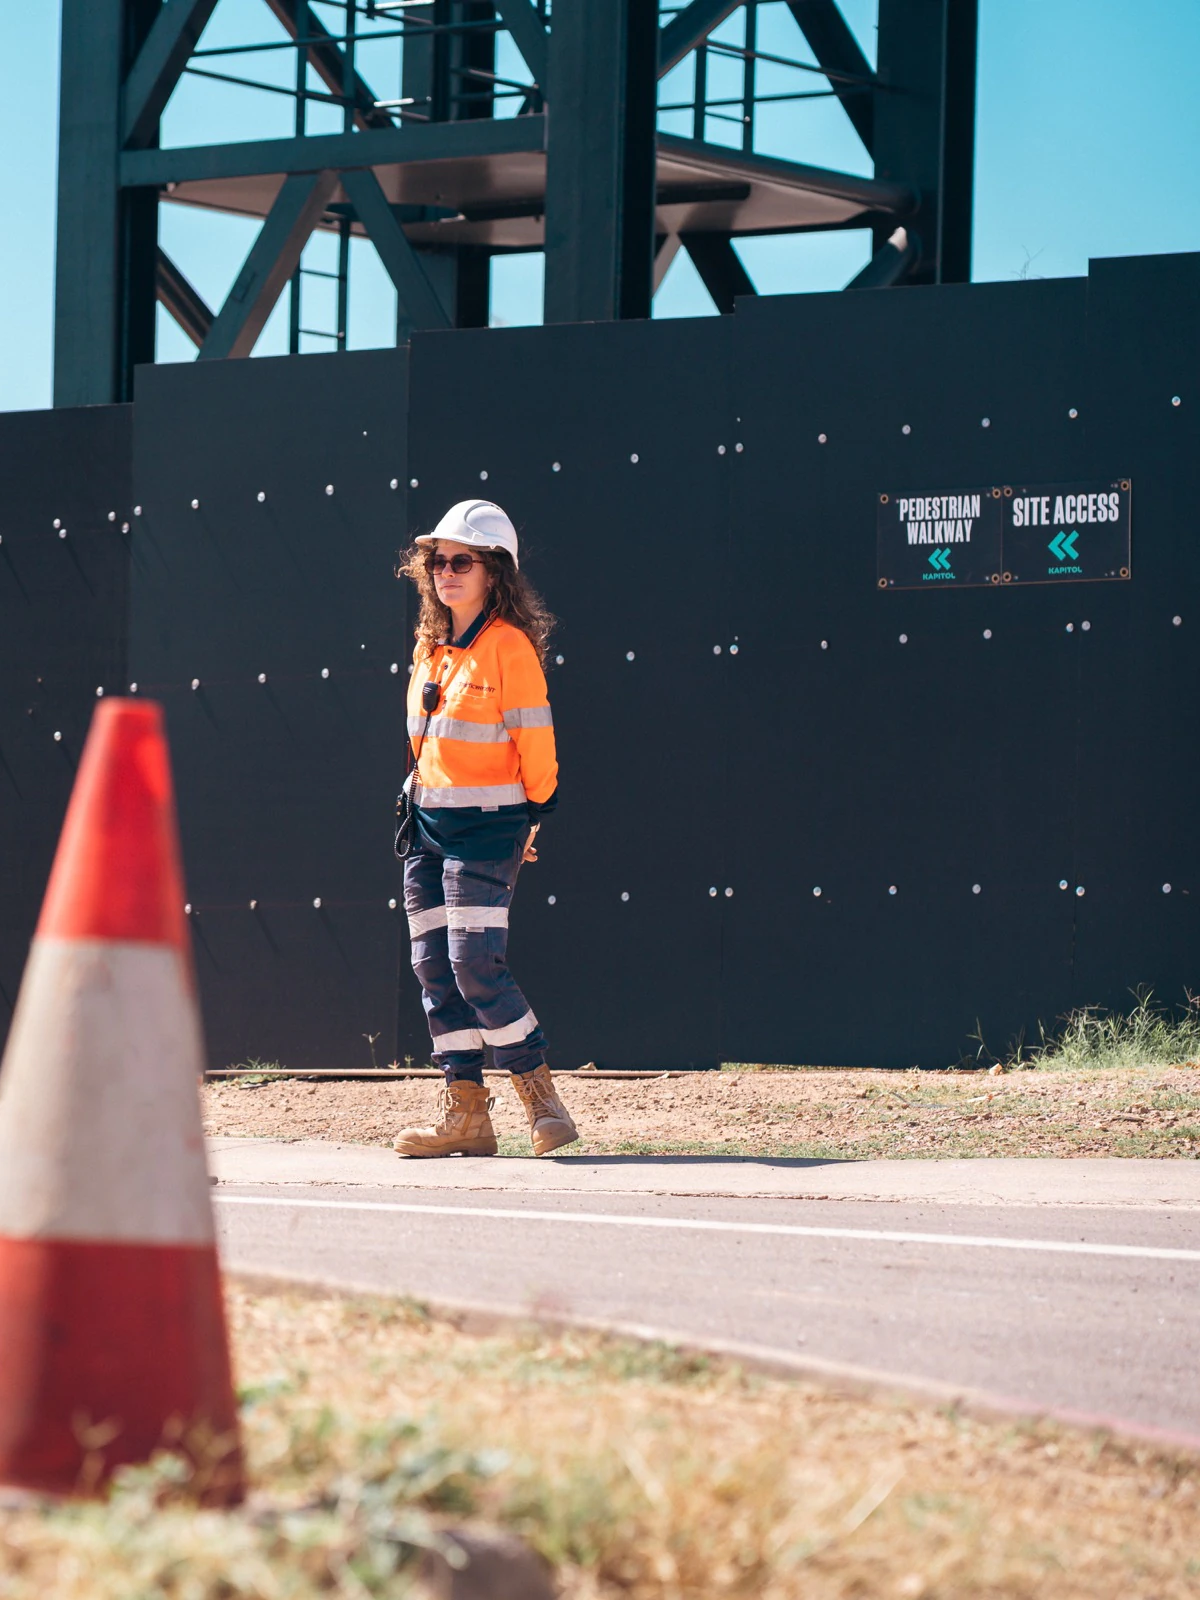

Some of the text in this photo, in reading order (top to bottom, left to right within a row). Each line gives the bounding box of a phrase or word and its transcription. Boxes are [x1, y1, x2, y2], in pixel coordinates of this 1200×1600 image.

[899, 494, 981, 521] PEDESTRIAN
[1012, 492, 1120, 527] SITE ACCESS
[906, 519, 973, 545] WALKWAY
[922, 571, 956, 581] KAPITOL
[1048, 566, 1083, 575] KAPITOL
